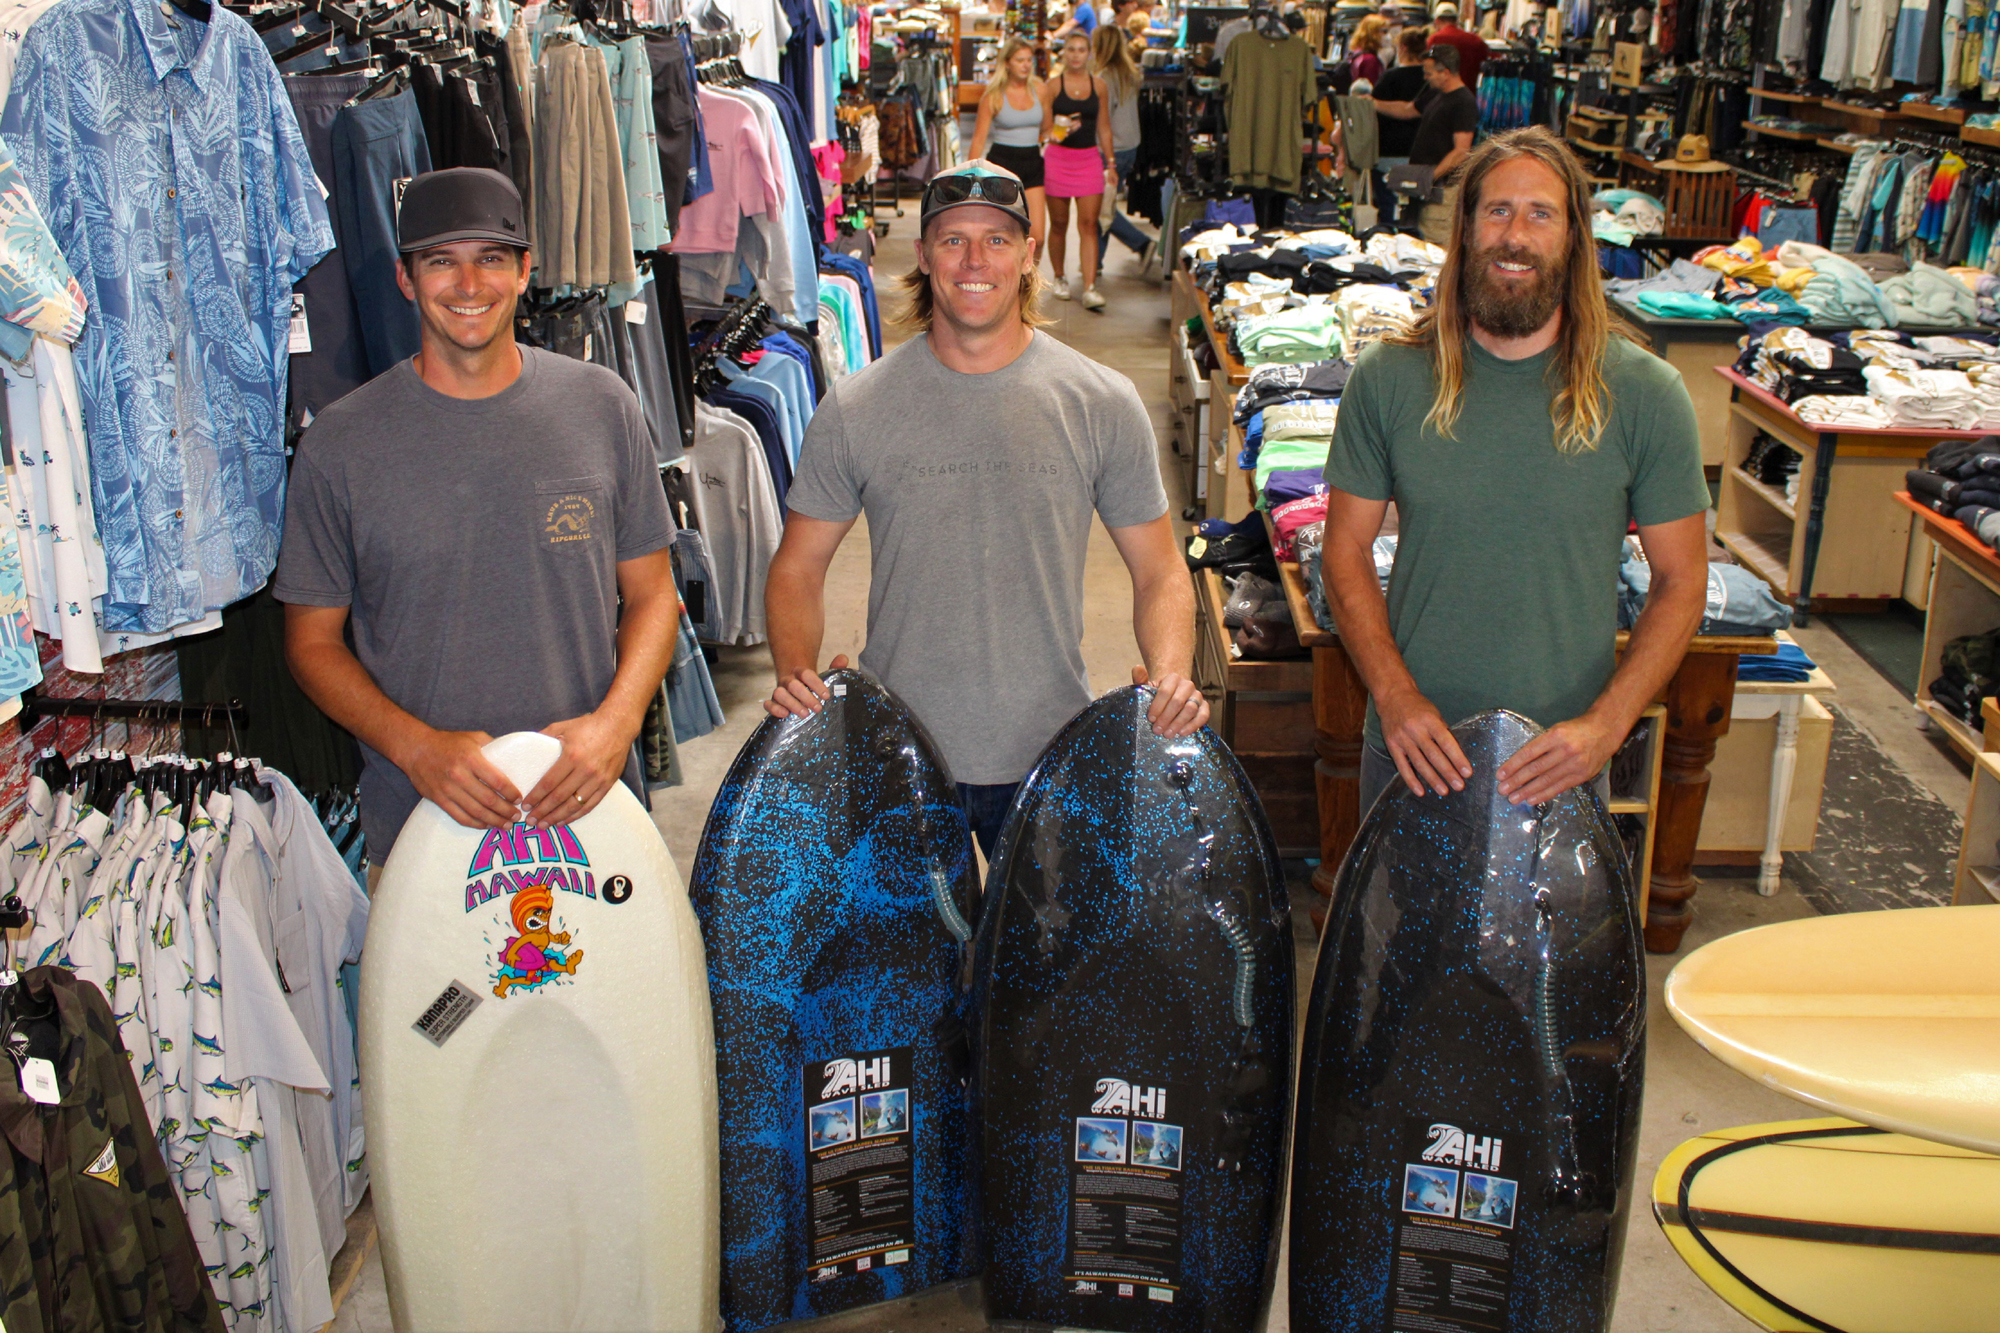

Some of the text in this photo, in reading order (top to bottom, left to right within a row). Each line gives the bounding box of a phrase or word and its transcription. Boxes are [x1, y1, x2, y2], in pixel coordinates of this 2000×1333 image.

[918, 462, 979, 478] SEARCH
[1018, 462, 1058, 475] SEAS
[467, 822, 591, 879] AHI
[465, 867, 597, 913] HAWAII
[416, 986, 460, 1031] KANAPRO
[428, 1018, 446, 1036] SUPER
[442, 994, 468, 1021] STRENGTH
[821, 1081, 890, 1099] WAVE SLED
[1091, 1108, 1165, 1119] WAVE SLED
[1422, 1154, 1499, 1171] WAVE SLED
[826, 1252, 847, 1262] ALWAYS
[847, 1245, 875, 1256] OVERHEAD
[1109, 1272, 1139, 1280] OVERHEAD
